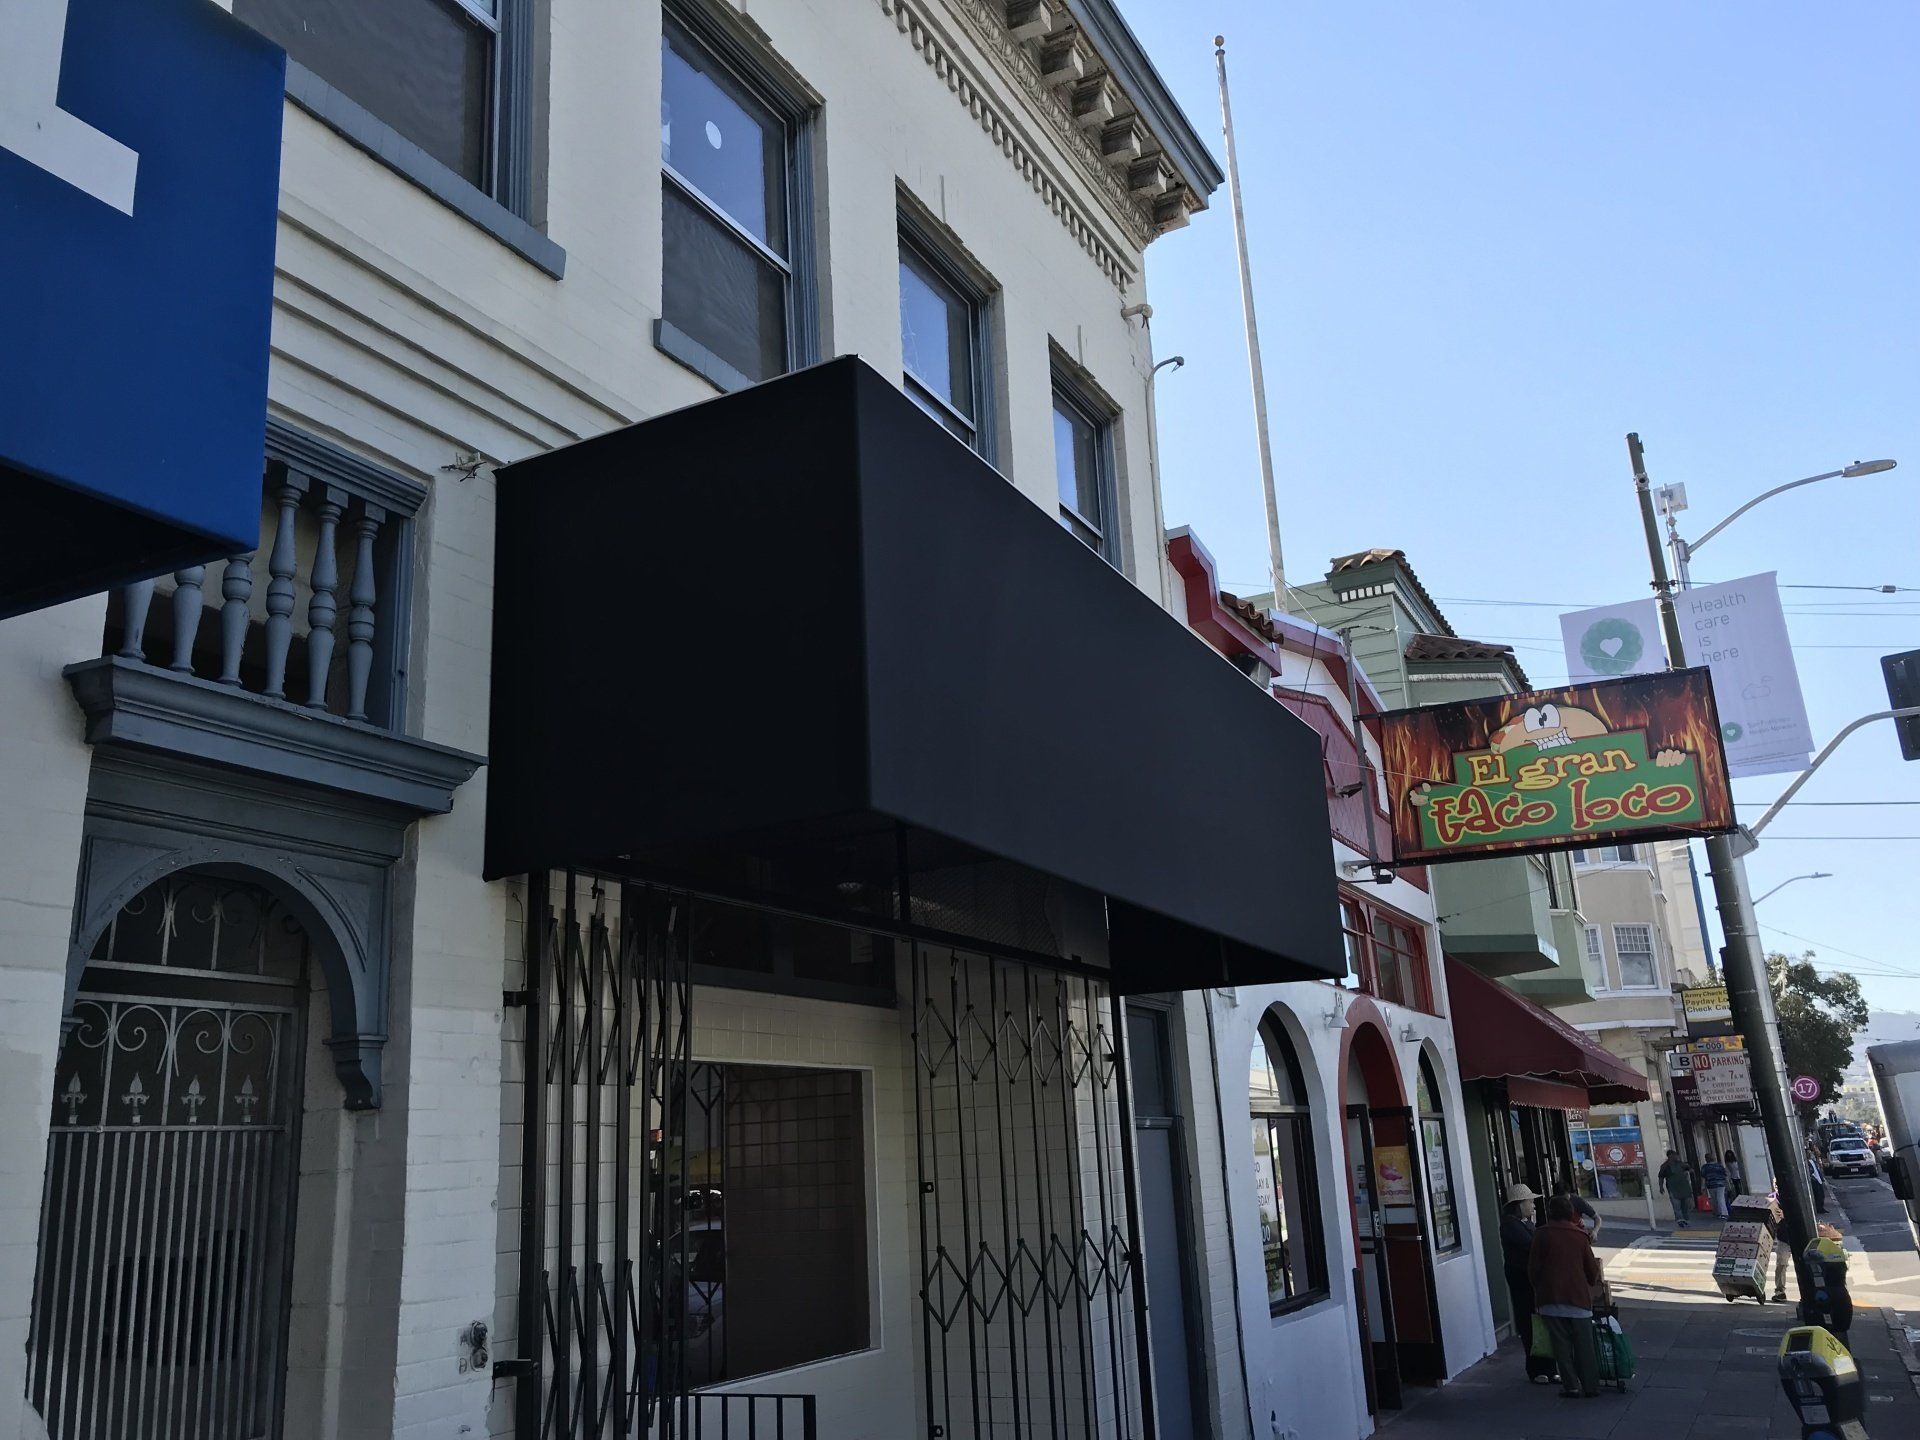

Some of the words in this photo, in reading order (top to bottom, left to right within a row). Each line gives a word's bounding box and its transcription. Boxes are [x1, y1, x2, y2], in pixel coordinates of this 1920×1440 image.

[1690, 591, 1746, 614] Health
[1695, 615, 1730, 631] care
[1698, 635, 1712, 648] is
[1702, 648, 1739, 663] here
[1467, 753, 1510, 786] El
[1514, 748, 1637, 790] gran
[1568, 777, 1695, 831] loco
[1685, 997, 1715, 1006] Payday
[1686, 1005, 1712, 1013] Check
[1693, 1055, 1709, 1069] NO
[1711, 1055, 1745, 1067] PARKING
[1798, 1082, 1814, 1094] 17
